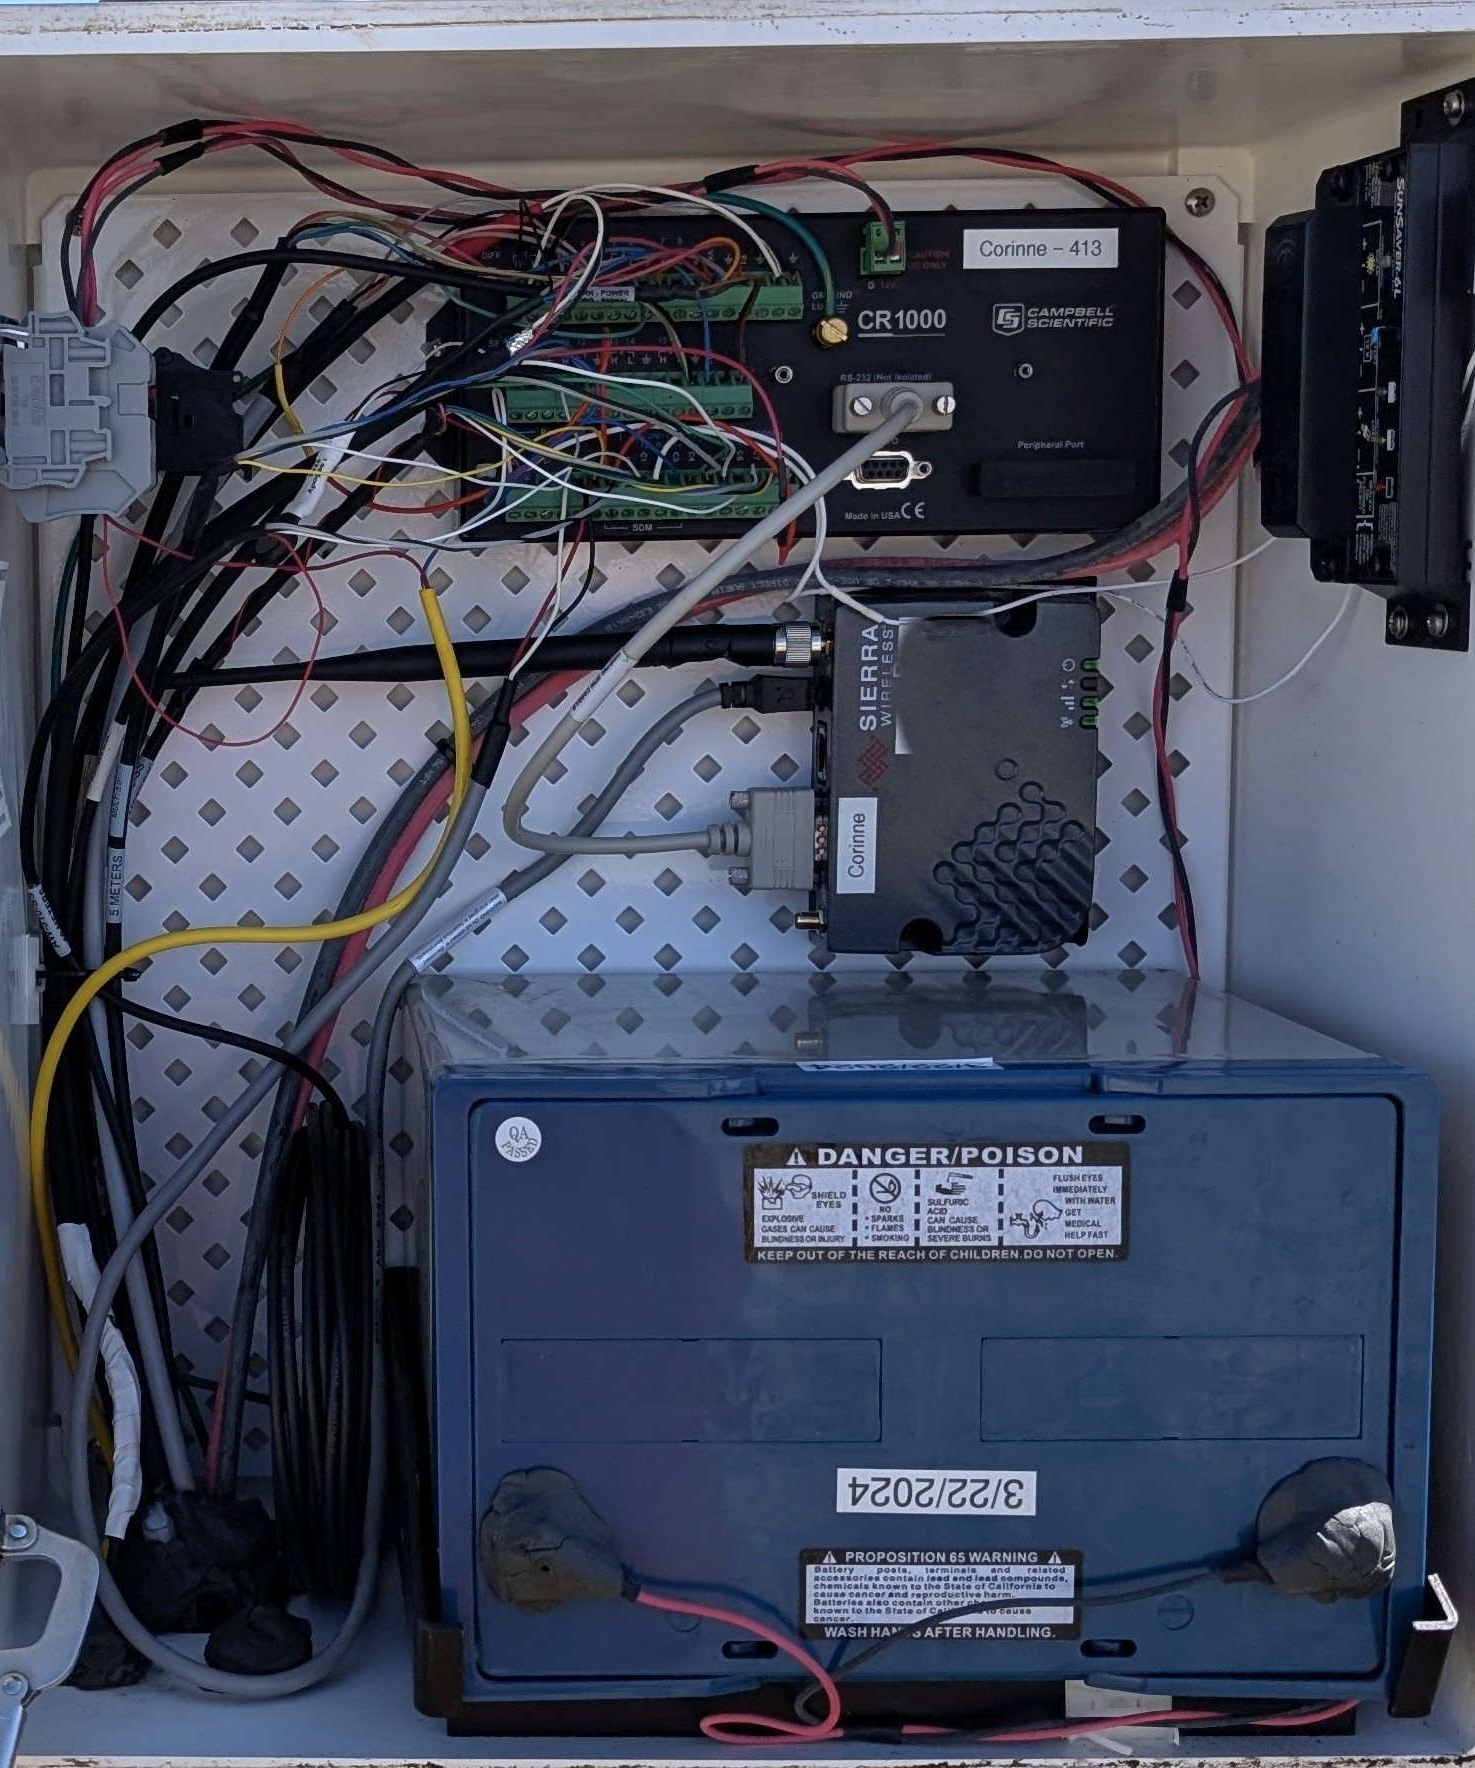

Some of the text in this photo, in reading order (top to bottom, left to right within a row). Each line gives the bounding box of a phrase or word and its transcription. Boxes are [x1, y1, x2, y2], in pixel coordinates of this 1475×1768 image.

[979, 240, 1047, 257] Corinne
[1069, 240, 1102, 257] 413
[1028, 307, 1113, 317] CAMPBELL
[858, 309, 946, 330] CR1000
[1027, 318, 1113, 328] SCIENTIFIC
[1018, 440, 1084, 450] Peripheral Port
[860, 624, 879, 731] SIERRA
[881, 628, 894, 727] WIRELESS
[847, 812, 866, 878] Corinne
[110, 855, 122, 905] METERS
[509, 1125, 528, 1143] QA
[817, 1146, 1083, 1166] DANGER/POISON
[1053, 1174, 1103, 1182] FLUSH EYES
[927, 1216, 978, 1224] CAN CAUSE
[762, 1225, 787, 1233] GASES
[872, 1224, 905, 1232] FLAMES
[762, 1235, 845, 1243] BLINDNESS OR INJURY
[1065, 1231, 1108, 1239] HELP FAST
[757, 1250, 793, 1260] KEEP
[796, 1250, 825, 1260] OUT
[827, 1250, 846, 1260] OF
[849, 1250, 874, 1260] THE
[877, 1250, 925, 1260] REACH
[929, 1250, 947, 1259] OF
[1047, 1249, 1079, 1258] NOT
[1082, 1249, 1119, 1258] OPEN.
[848, 1476, 1024, 1510] 3/22/2024
[845, 1551, 1038, 1563] PROPOSITION 65 WARNING
[814, 1566, 854, 1574] Battery
[926, 1566, 977, 1574] terminals
[1001, 1575, 1068, 1583] compounds,
[911, 1591, 981, 1599] reproductive
[936, 1599, 967, 1607] other
[824, 1627, 867, 1637] WASH
[924, 1627, 975, 1638] AFTER
[976, 1627, 1056, 1638] HANDLING.
